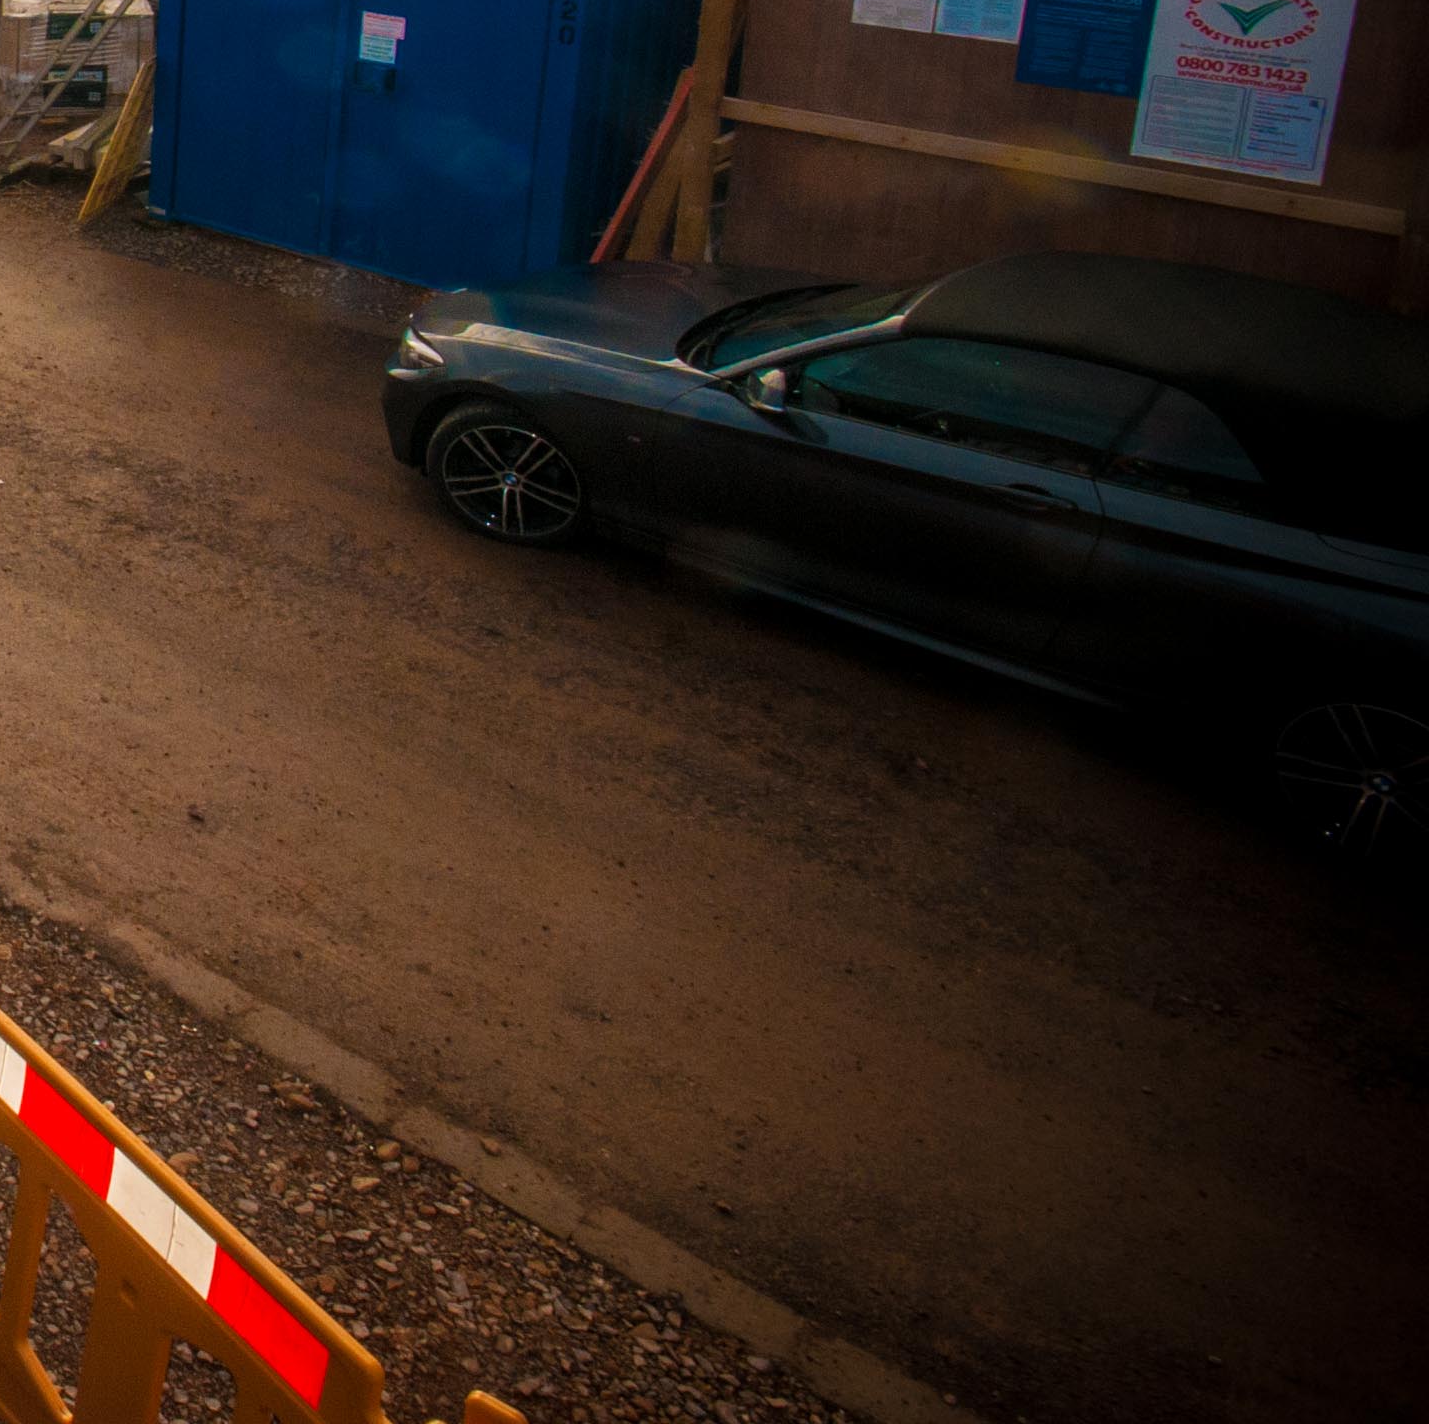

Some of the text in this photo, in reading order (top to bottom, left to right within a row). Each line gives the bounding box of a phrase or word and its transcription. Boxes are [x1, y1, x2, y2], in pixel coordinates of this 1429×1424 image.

[1185, 10, 1316, 50] CONSTRUCTORS
[1177, 56, 1308, 84] 0800 783 1423
